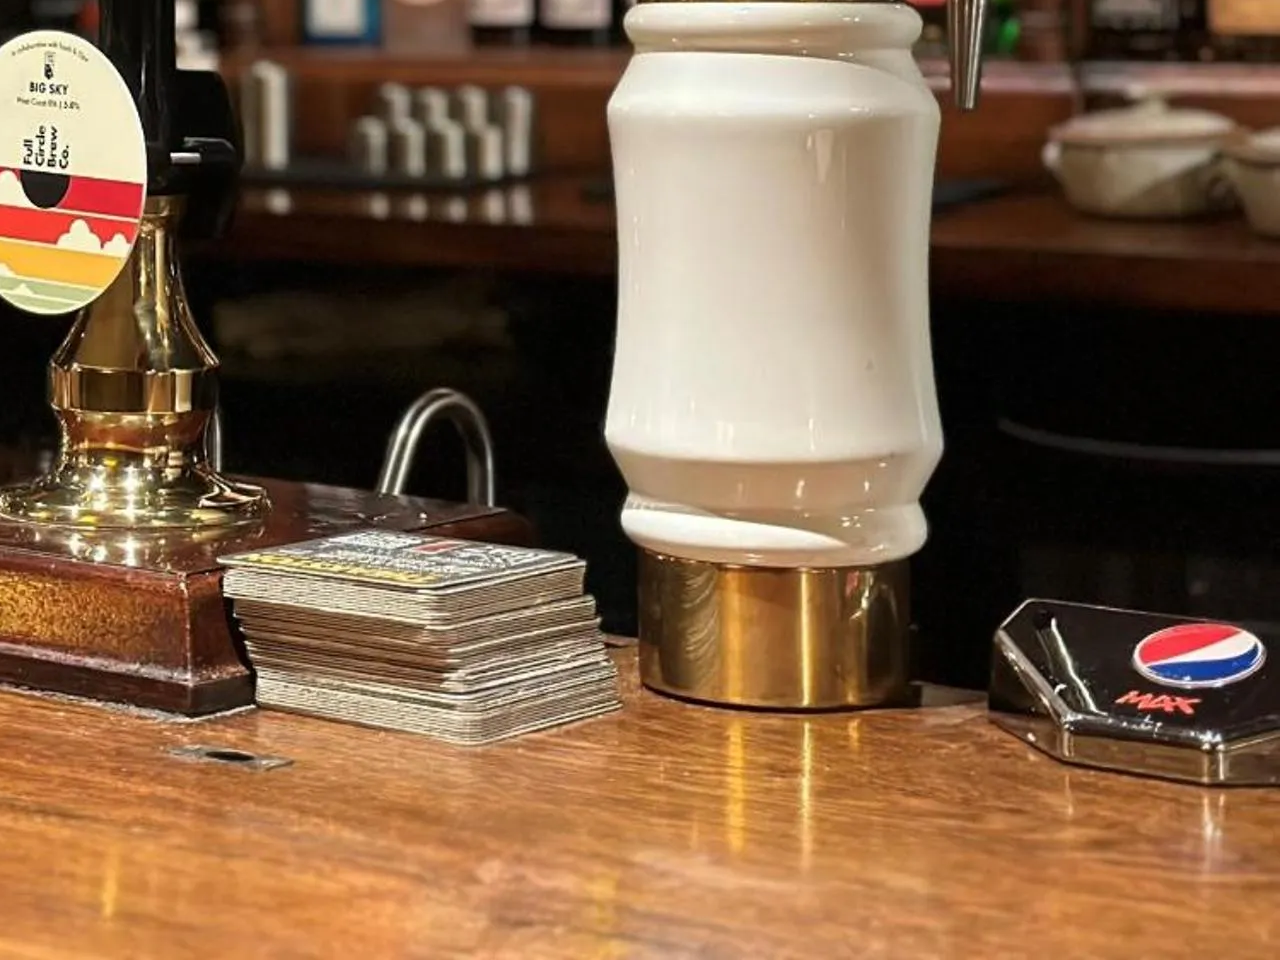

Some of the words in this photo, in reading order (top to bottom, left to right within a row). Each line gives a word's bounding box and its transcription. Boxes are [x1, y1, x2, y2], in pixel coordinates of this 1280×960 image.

[29, 81, 47, 94] BIG
[49, 83, 69, 96] SKY
[23, 138, 33, 166] Full
[35, 125, 47, 167] Circle
[47, 125, 58, 168] Brew
[58, 144, 70, 170] Co.
[1116, 690, 1202, 715] MAX
